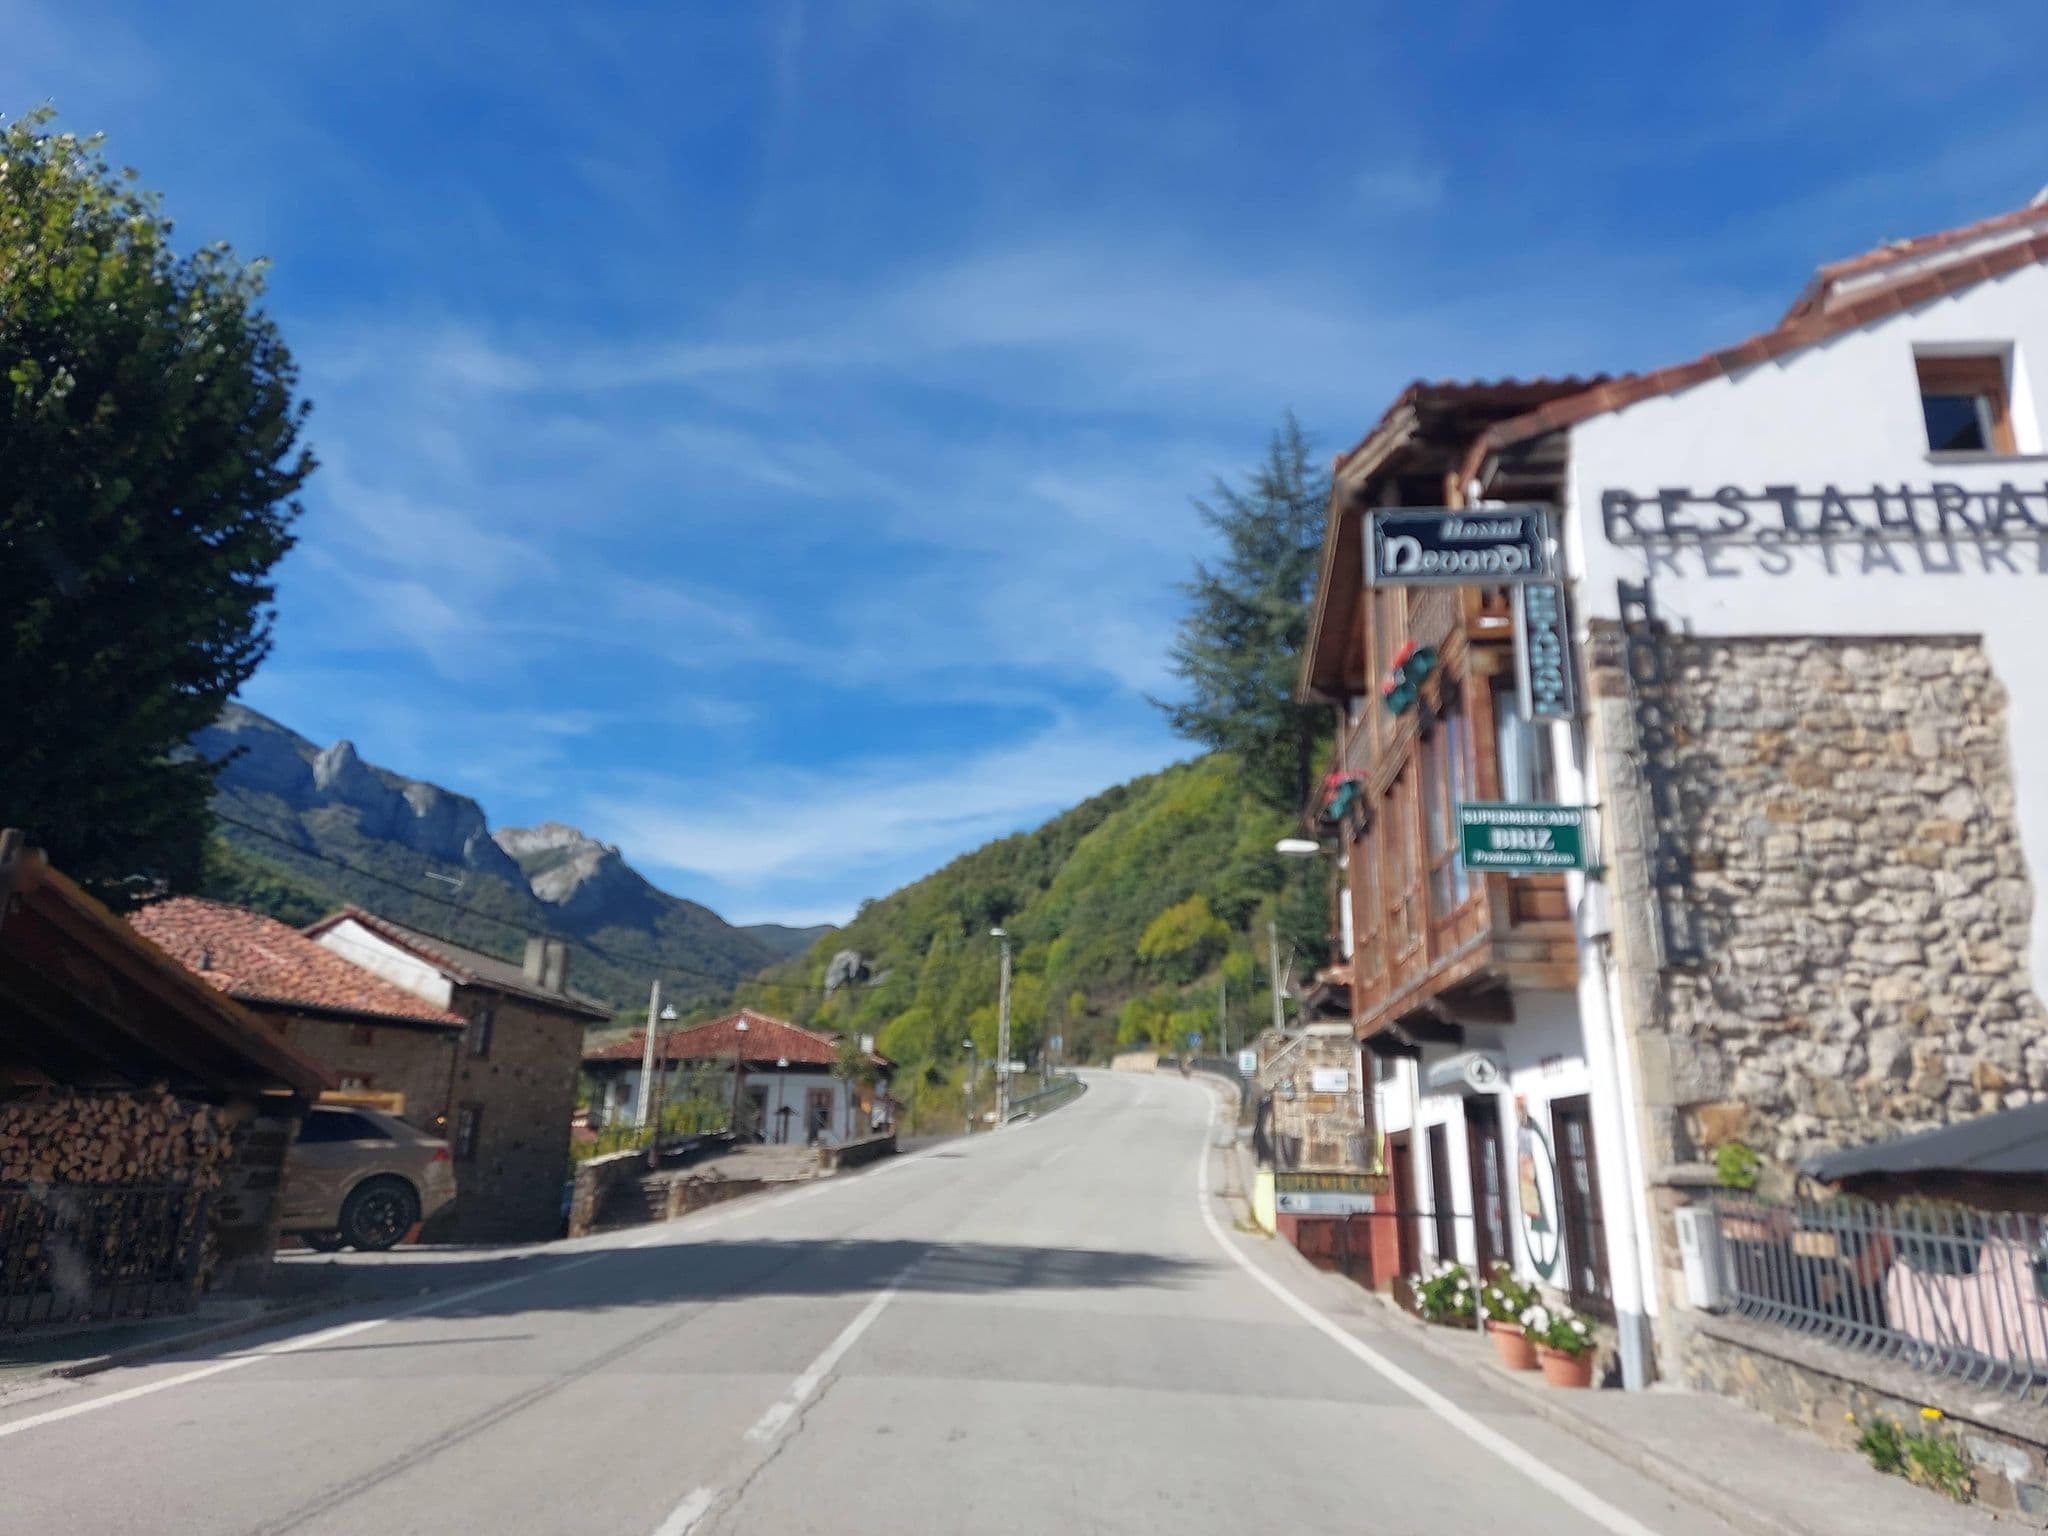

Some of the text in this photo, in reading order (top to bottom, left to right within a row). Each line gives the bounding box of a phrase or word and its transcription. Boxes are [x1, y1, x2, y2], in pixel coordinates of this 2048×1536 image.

[1602, 485, 2048, 540] RESTAURA
[1463, 809, 1581, 826] SUPERMERCADO
[1490, 828, 1554, 850] BRIZ
